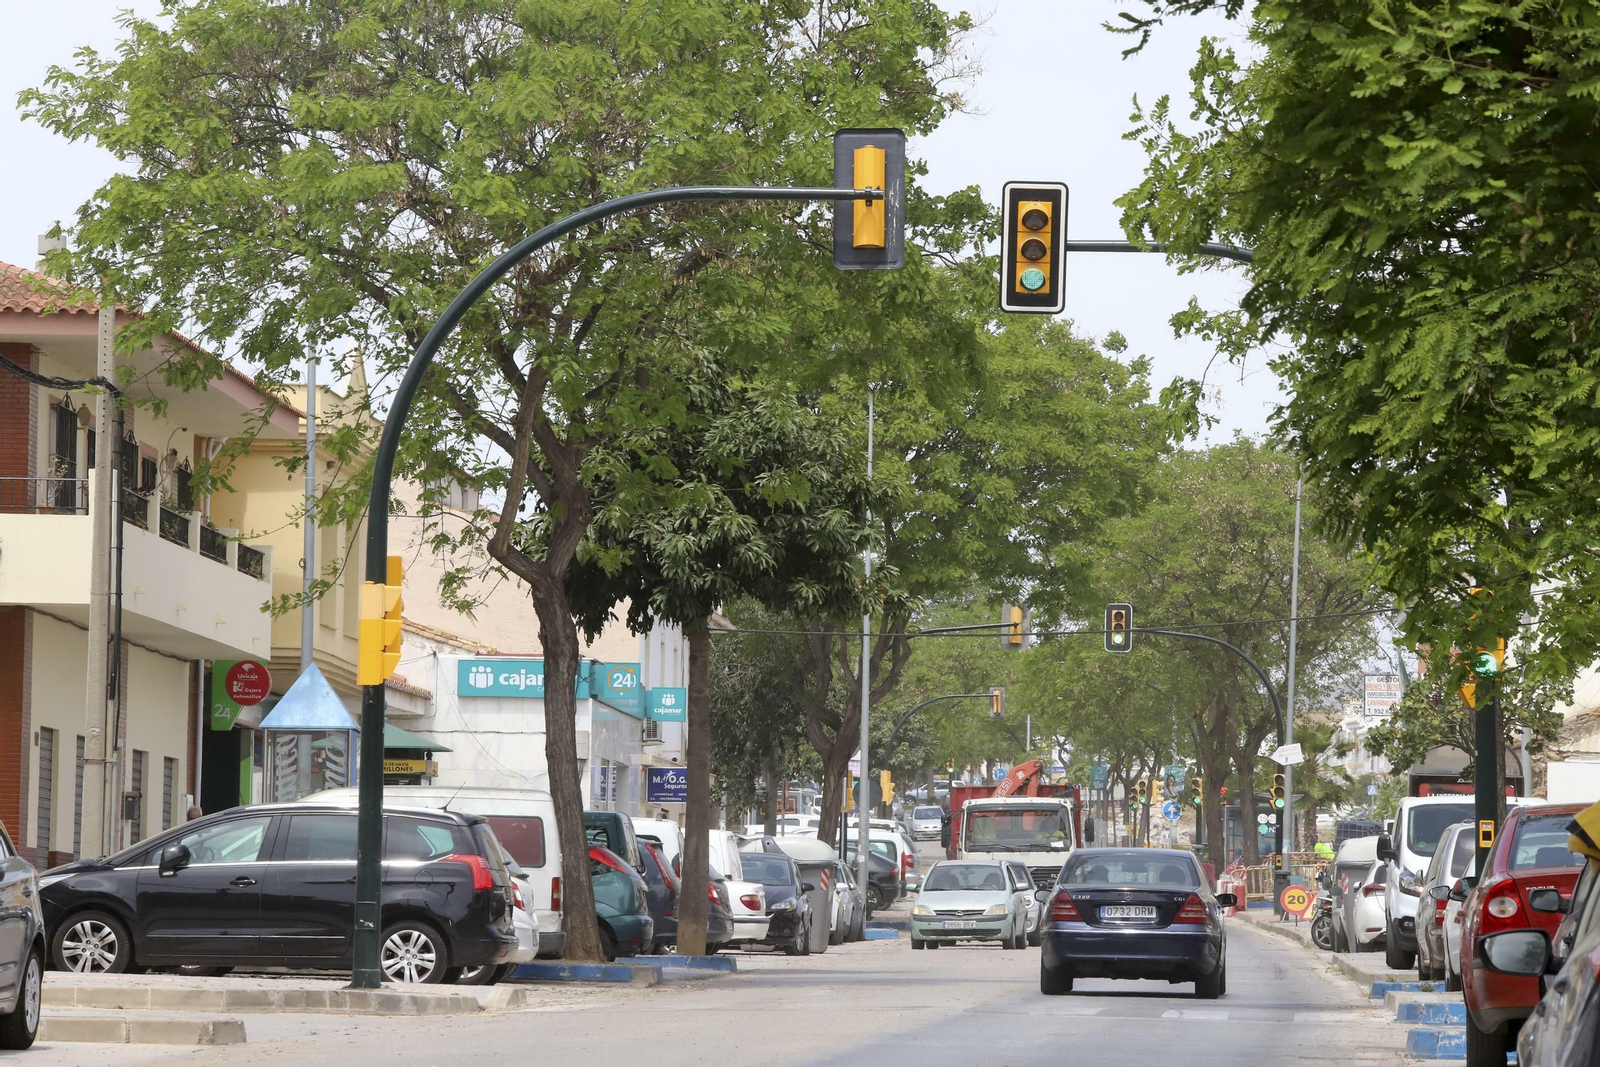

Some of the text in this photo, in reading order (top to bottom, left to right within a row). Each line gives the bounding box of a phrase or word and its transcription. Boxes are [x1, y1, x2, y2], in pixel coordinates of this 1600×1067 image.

[214, 704, 231, 721] 24
[654, 706, 682, 714] cajamar
[1287, 895, 1305, 904] 20
[1106, 907, 1153, 916] 0732 DRM
